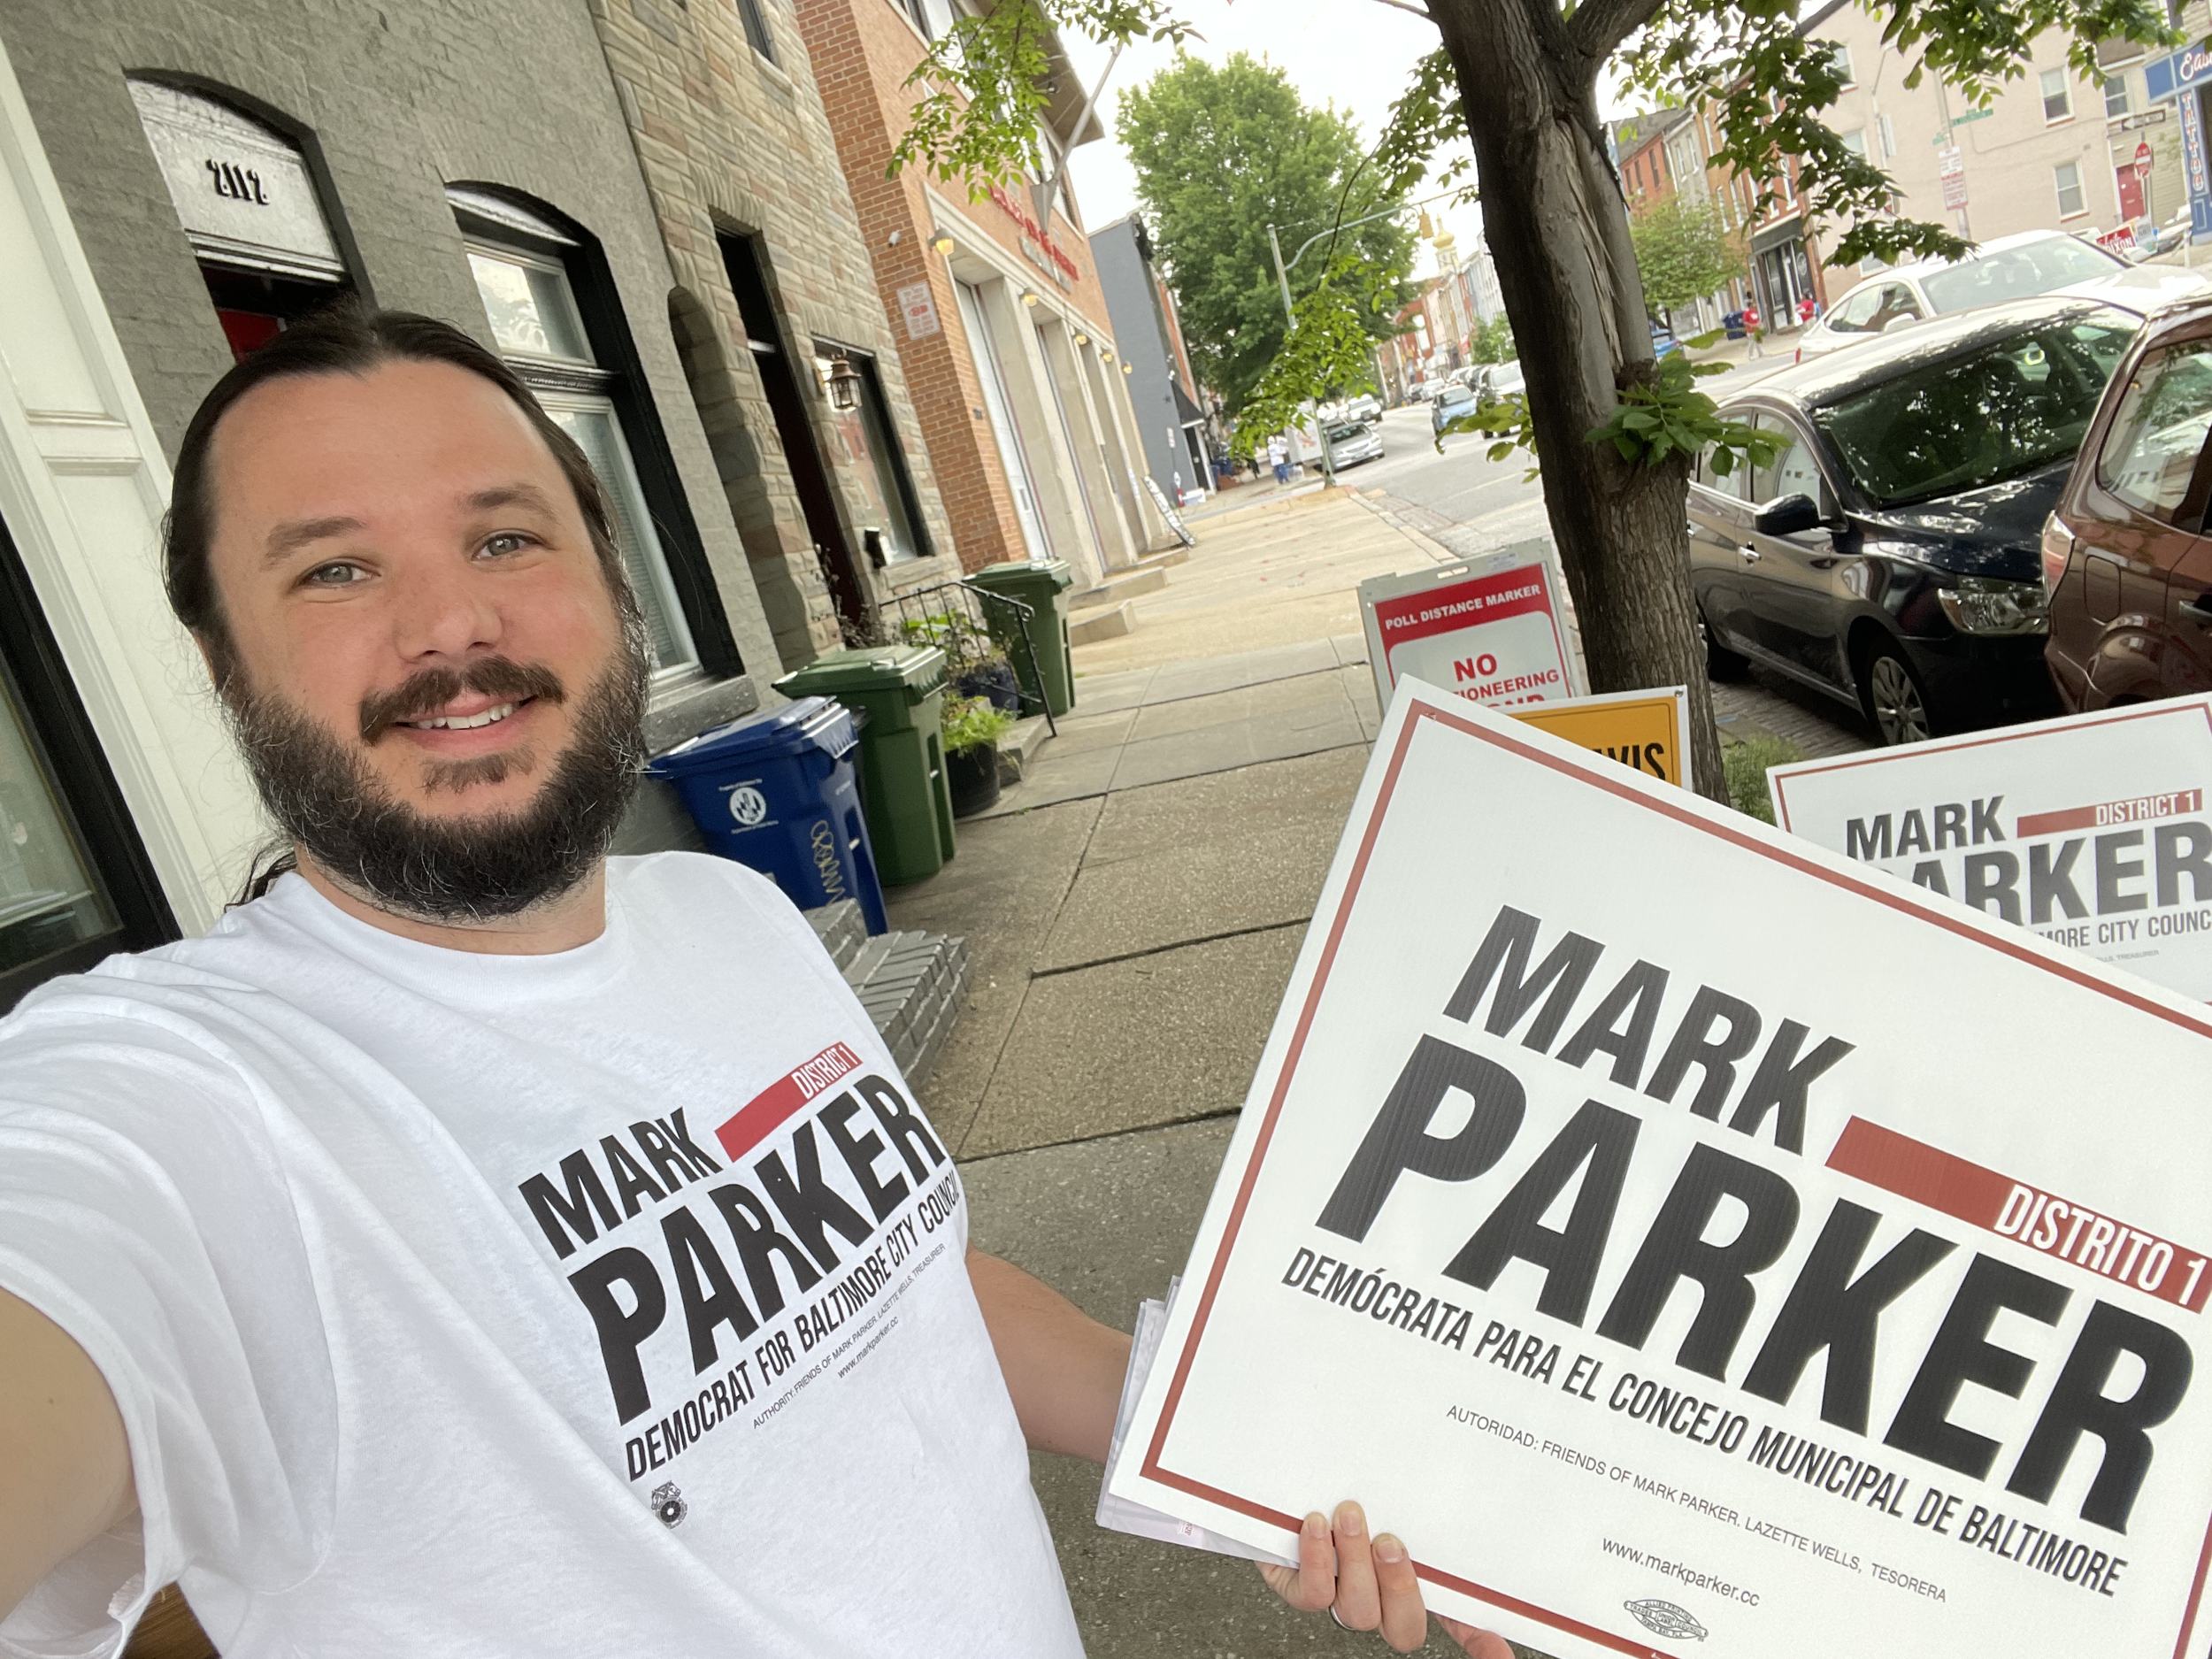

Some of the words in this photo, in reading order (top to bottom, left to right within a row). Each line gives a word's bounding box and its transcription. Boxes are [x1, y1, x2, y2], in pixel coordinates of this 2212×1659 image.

[205, 159, 270, 205] 2112
[2182, 93, 2203, 191] TATTOO
[1386, 613, 1417, 630] POLL
[1420, 597, 1483, 621] DISTANCE
[1486, 584, 1541, 607] MARKER
[1453, 669, 1559, 701] IONEERING
[1454, 653, 1497, 682] NO
[1847, 795, 2006, 862] MARK
[2094, 794, 2178, 826] DISTRICT
[2185, 791, 2195, 811] 1
[2098, 918, 2139, 944] CITY
[1443, 905, 1855, 1156] MARK
[792, 1048, 847, 1099] DISTRICT
[840, 1045, 857, 1064] 1
[518, 1106, 724, 1260] MARK
[567, 1073, 946, 1426] PARKER
[1316, 1033, 2194, 1534] PARKER
[1993, 1185, 2175, 1291] DISTRITO
[2177, 1257, 2207, 1305] 1
[626, 1360, 755, 1481] DEMOCRAT
[755, 1331, 795, 1386] FOR
[795, 1246, 891, 1352] BALTIMORE
[887, 1214, 918, 1267] CITY
[918, 1170, 959, 1233] COUNCIL
[753, 1389, 795, 1429] AUTHORITY:
[794, 1365, 822, 1393] FRIENDS
[821, 1355, 832, 1369] OF
[833, 1338, 853, 1360] MARK
[878, 1292, 900, 1318] LAZETTE
[912, 1242, 946, 1279] TREASURER
[838, 1316, 899, 1379] www.markparker.cc
[1282, 1248, 1473, 1350] DEMÓCRATA
[1473, 1321, 1561, 1384] PARA
[1562, 1355, 1602, 1401] EL
[1609, 1373, 1748, 1453] CONCEJO
[1747, 1425, 1908, 1517] MUNICIPAL
[1914, 1488, 1962, 1533] DE
[1960, 1505, 2127, 1596] BALTIMORE
[1447, 1406, 1538, 1449] AUTORIDAD:
[1542, 1440, 1606, 1474] FRIENDS
[1610, 1467, 1632, 1482] OF
[1633, 1475, 1678, 1502] MARK
[1679, 1493, 1740, 1526] PARKER.
[1746, 1517, 1809, 1551] LAZETTE
[1813, 1541, 1861, 1573] WELLS,
[1872, 1563, 1945, 1602] TESORERA
[1603, 1539, 1759, 1606] www.markparker.cc
